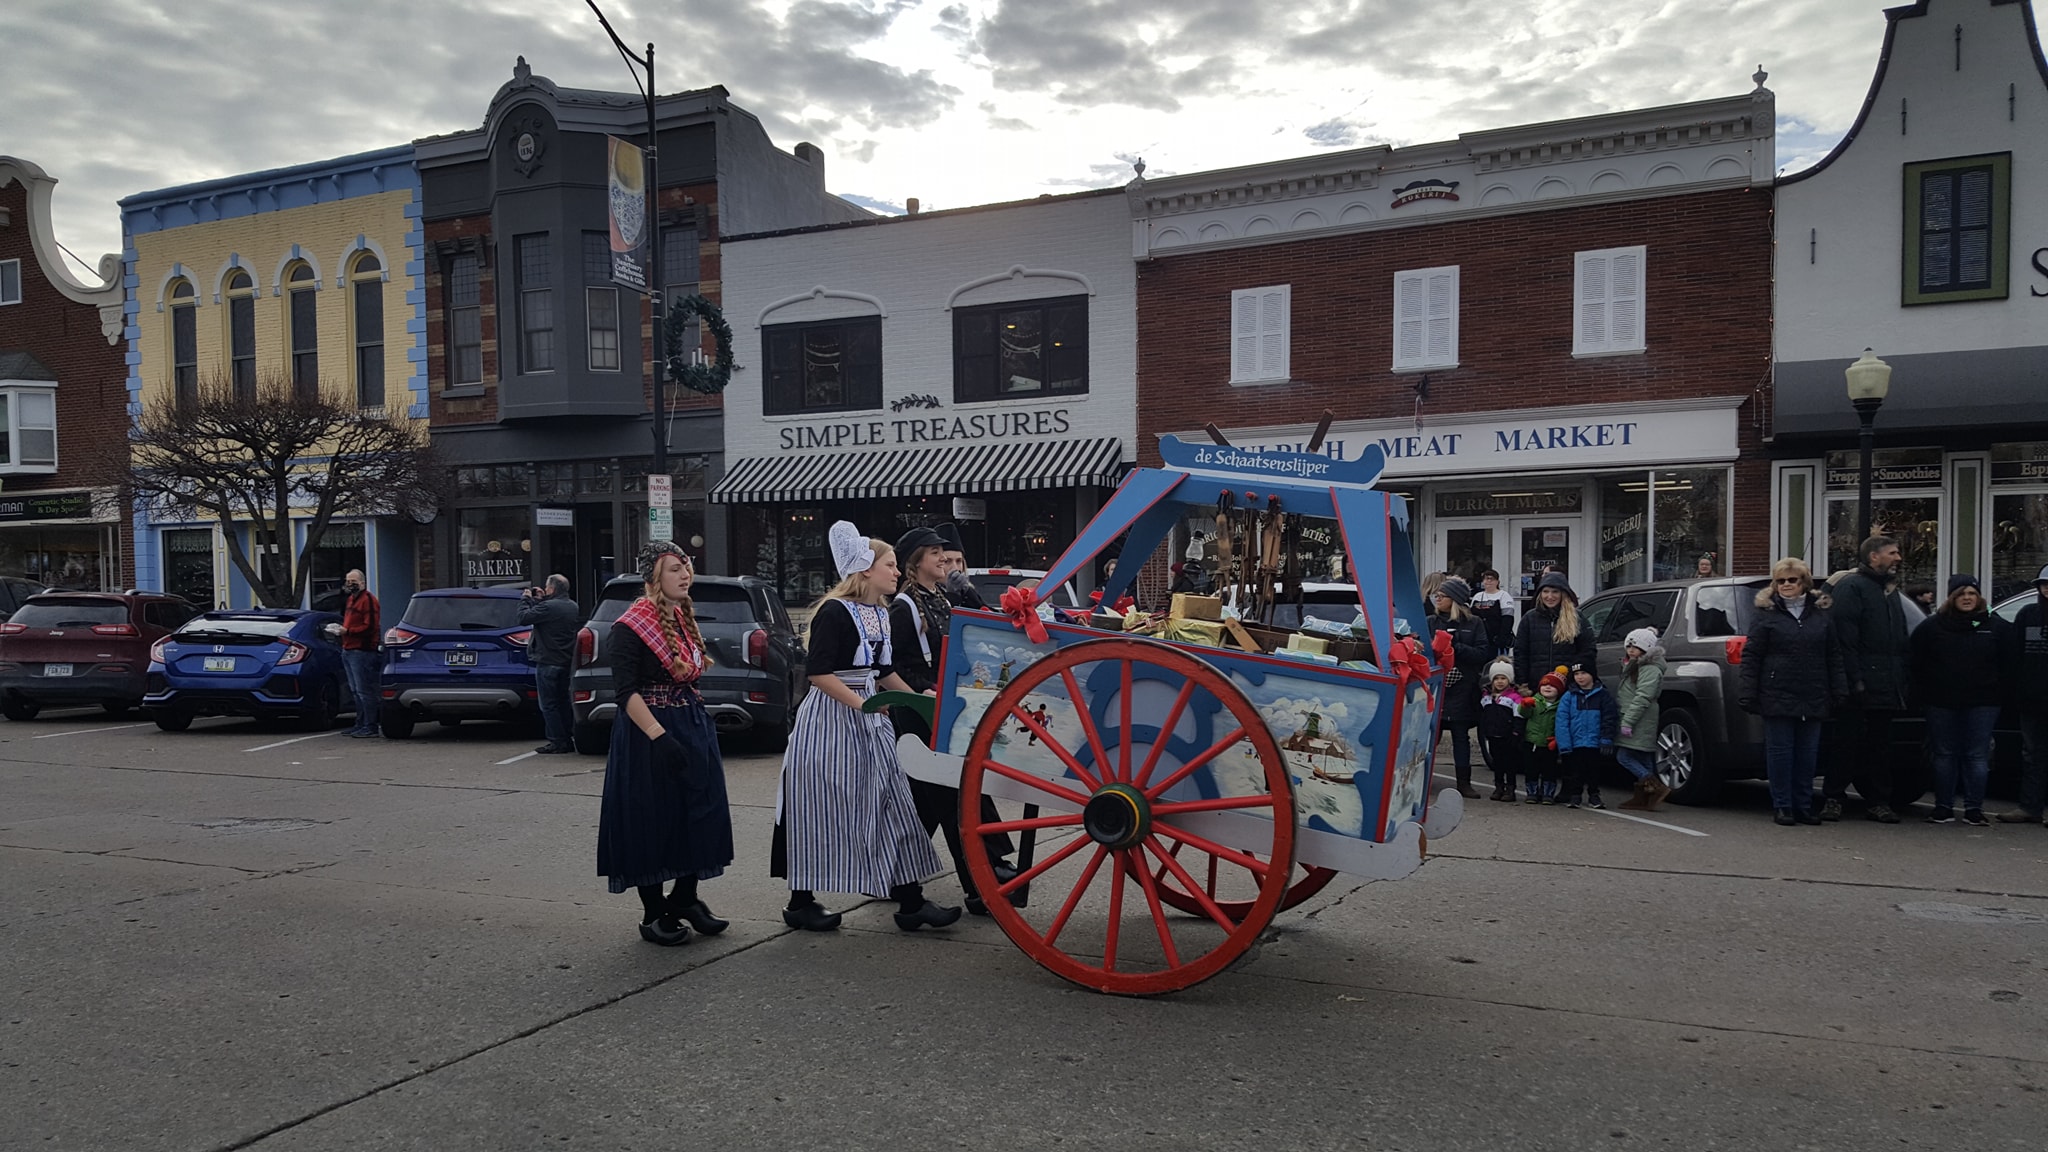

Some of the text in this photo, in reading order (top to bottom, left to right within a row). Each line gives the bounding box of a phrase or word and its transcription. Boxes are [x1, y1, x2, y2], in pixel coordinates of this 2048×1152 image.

[624, 254, 635, 263] The
[780, 409, 1070, 450] SIMPLE TREASURES
[1378, 433, 1462, 459] MEAT
[1495, 422, 1638, 452] MARKET
[1195, 448, 1213, 464] de
[1214, 449, 1330, 477] Schaatsenslijper
[1828, 466, 1941, 486] Frapp Smoothies
[0, 501, 23, 513] MAN
[28, 496, 84, 506] Cosmetic Studio
[37, 505, 75, 515] & Day Spa
[1443, 492, 1578, 511] ULRICH MEATS
[651, 510, 657, 519] 3
[1603, 512, 1642, 544] SLAGERIJ
[467, 559, 523, 576] BAKERY
[1600, 547, 1644, 575] Smokehouse
